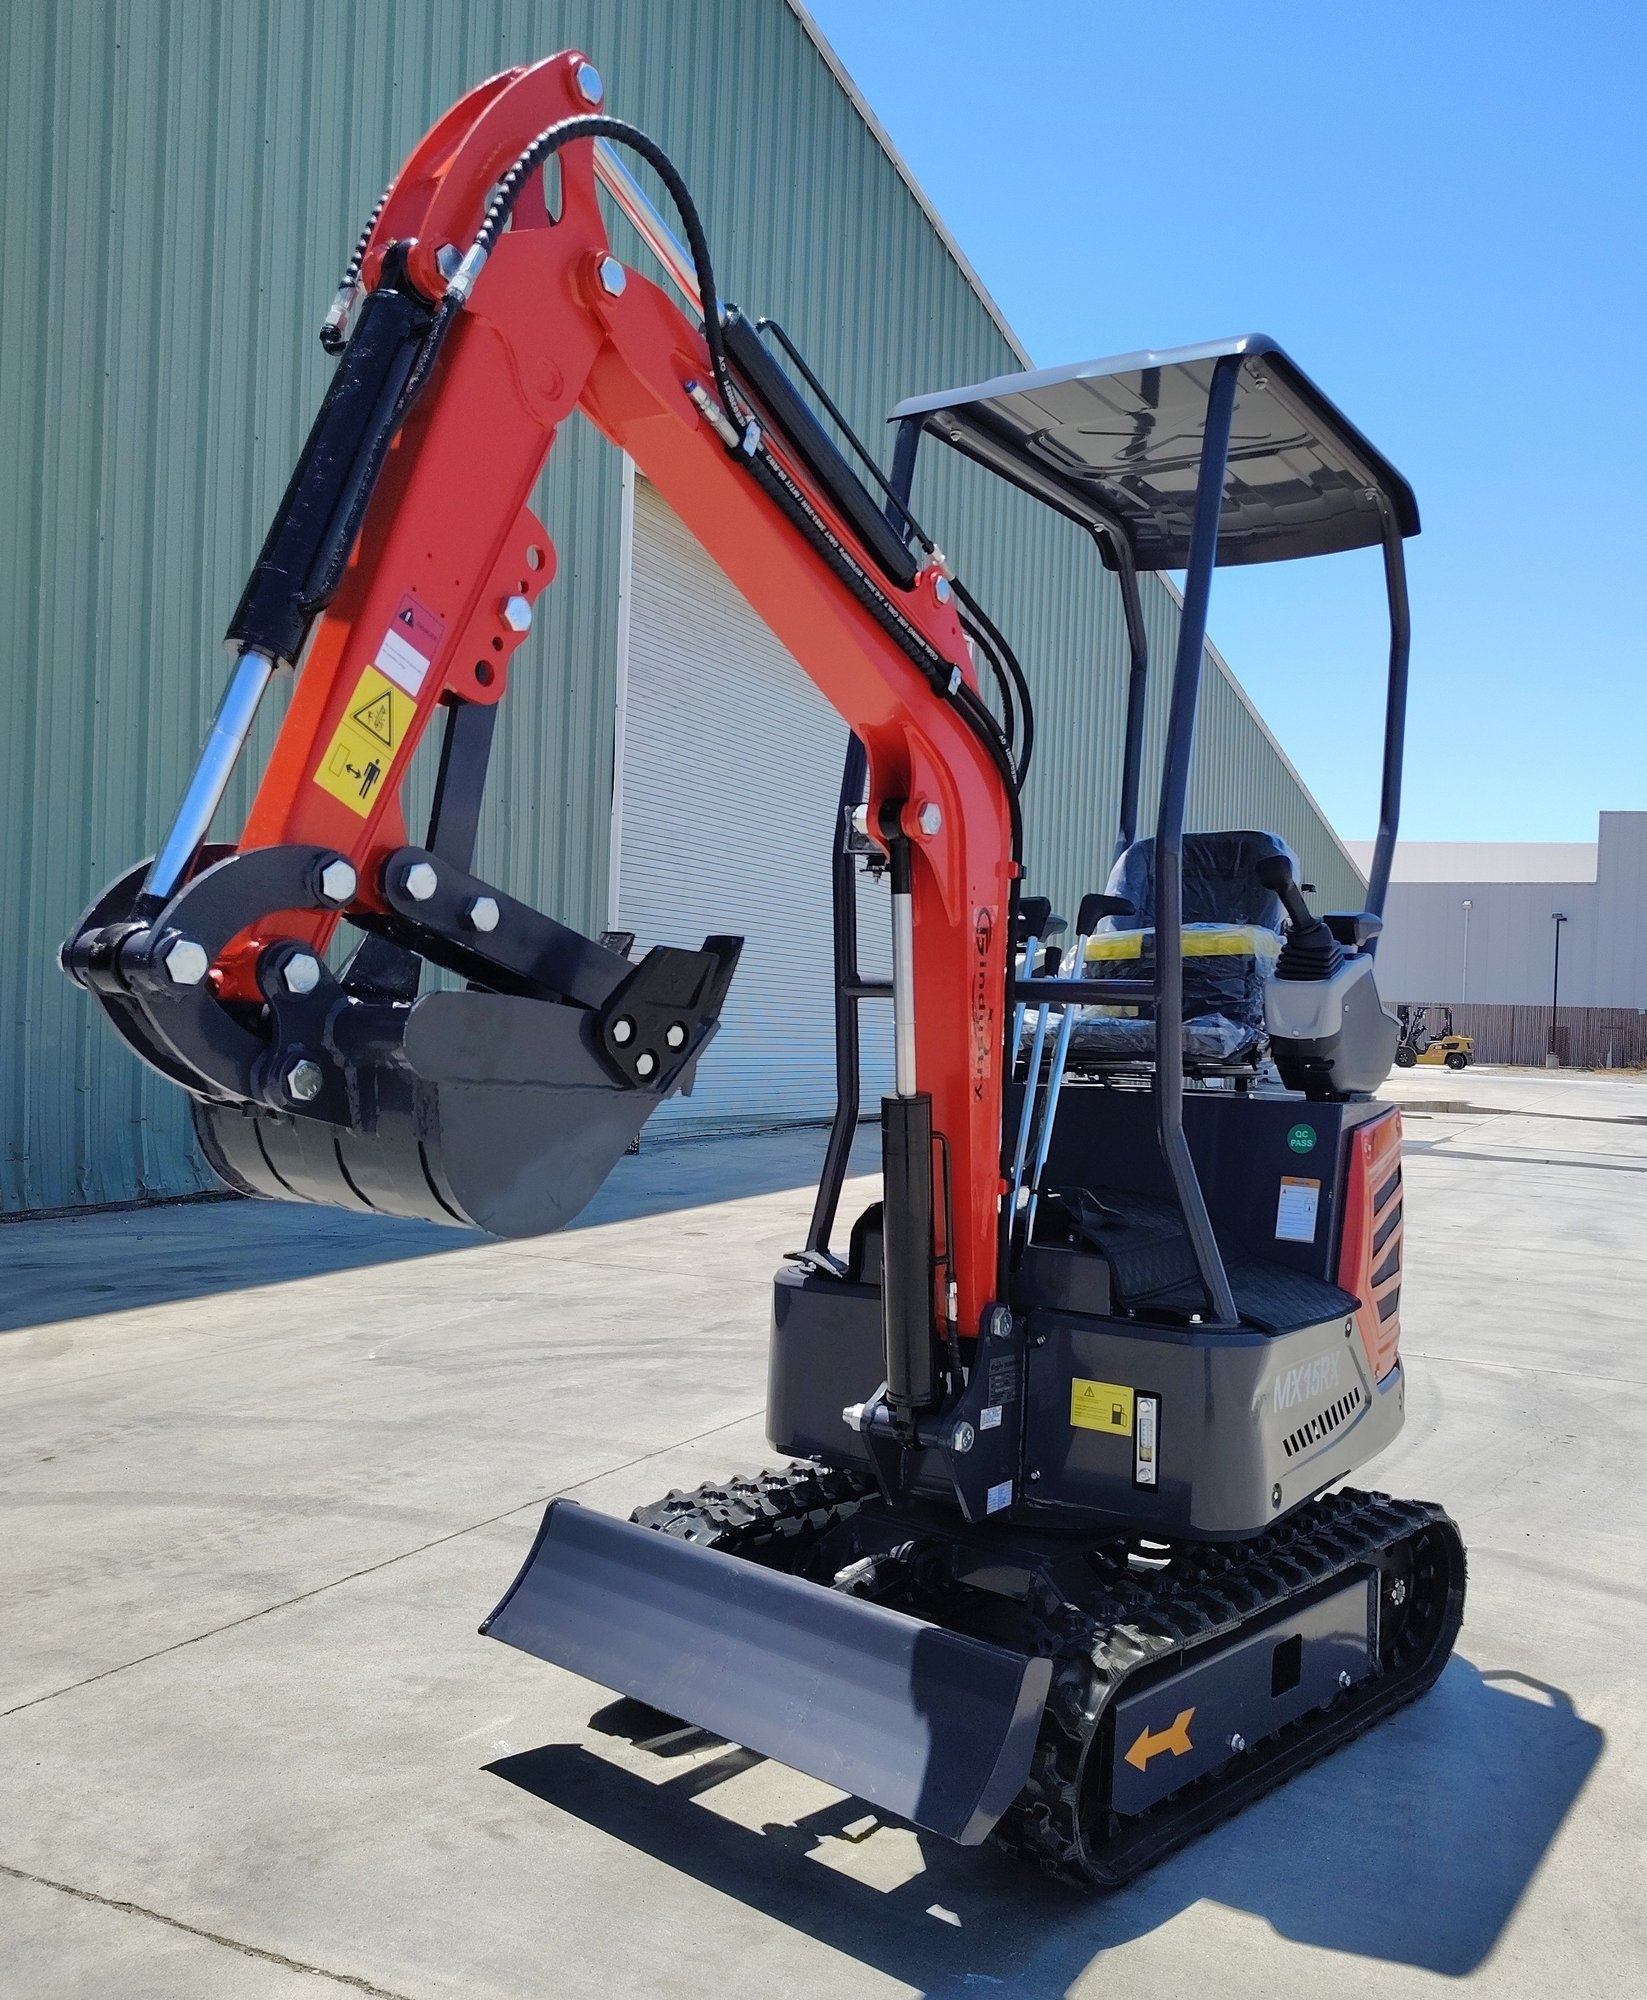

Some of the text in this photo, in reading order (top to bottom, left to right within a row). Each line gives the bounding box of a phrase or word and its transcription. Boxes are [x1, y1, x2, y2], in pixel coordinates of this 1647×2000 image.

[883, 602, 899, 618] ONLY
[897, 615, 909, 629] USE
[925, 644, 939, 660] COAL
[1295, 1130, 1308, 1138] QC
[1290, 1139, 1313, 1147] PASS
[1273, 1351, 1340, 1413] MX15RX
